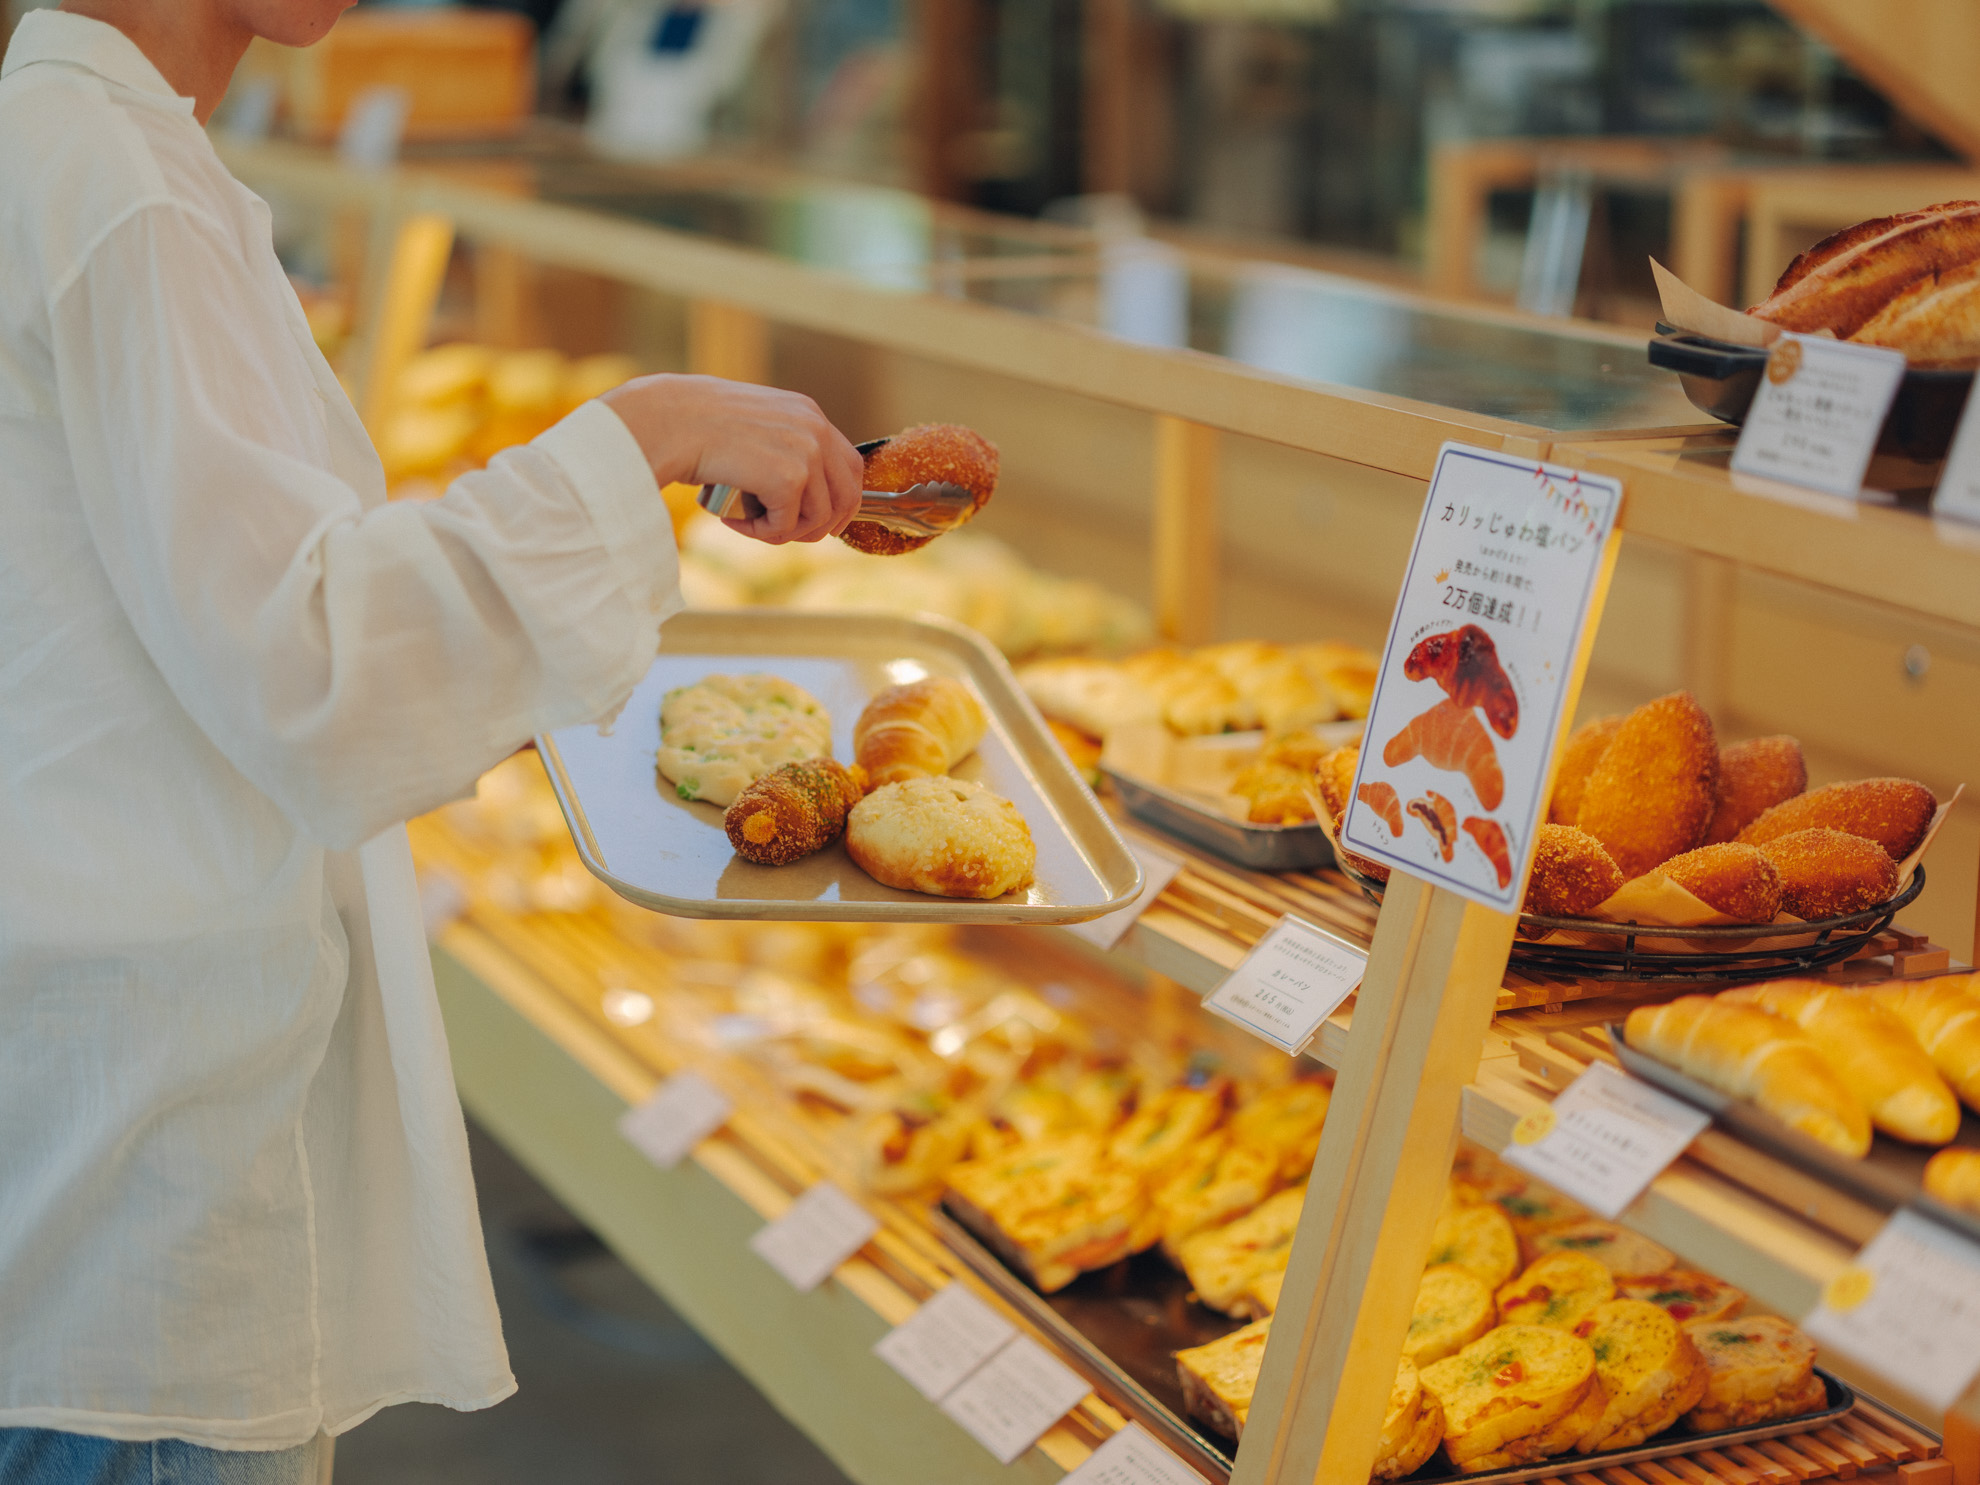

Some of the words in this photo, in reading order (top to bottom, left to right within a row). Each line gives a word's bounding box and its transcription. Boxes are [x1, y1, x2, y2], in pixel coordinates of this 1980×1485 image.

[1441, 502, 1583, 553] カリッじゅわ塩パン
[1272, 969, 1311, 991] カレーパン
